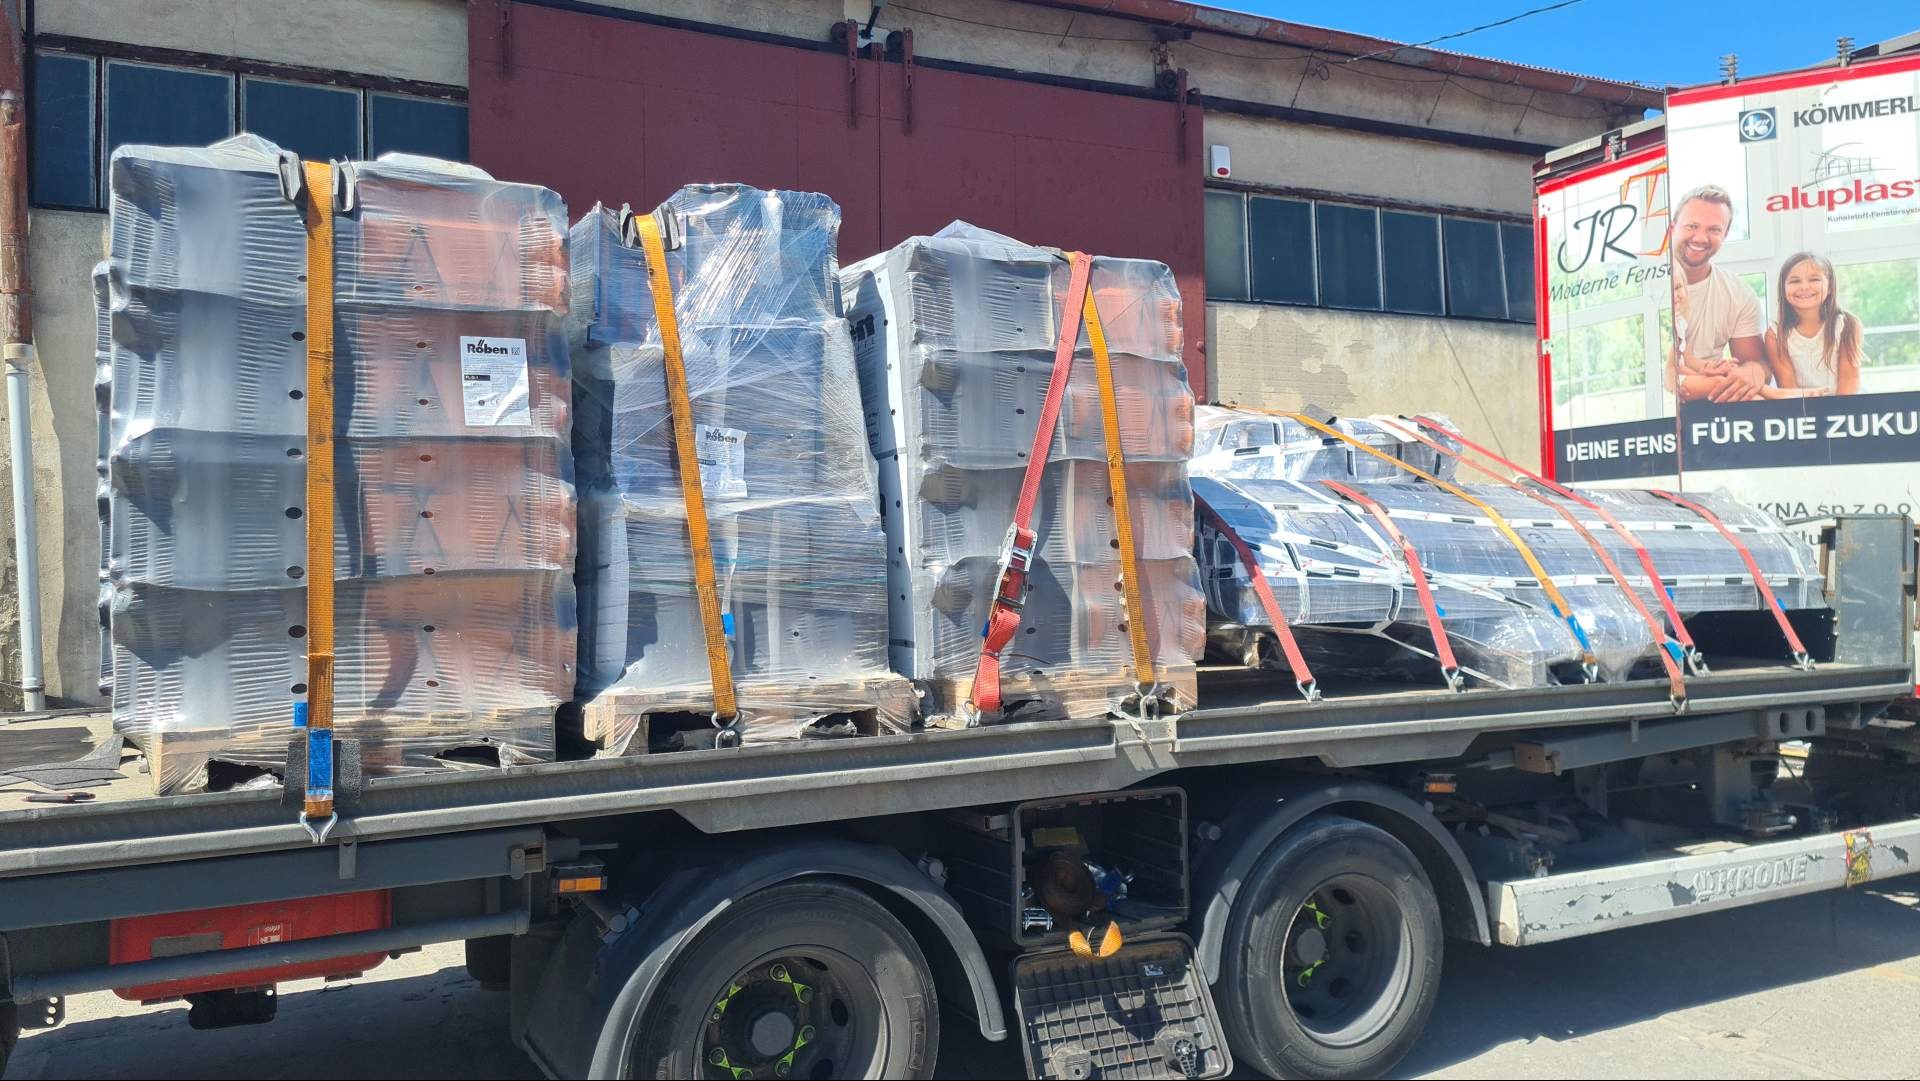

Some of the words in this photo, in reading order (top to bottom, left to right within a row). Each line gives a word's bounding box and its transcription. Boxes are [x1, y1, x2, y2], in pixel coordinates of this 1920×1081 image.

[1766, 179, 1920, 212] aluplas
[1557, 204, 1638, 274] JR
[1549, 274, 1619, 301] Moderne
[467, 339, 508, 355] Röben
[705, 428, 738, 444] Röben
[1692, 416, 1755, 446] FÜR
[1764, 416, 1817, 442] DIE
[1826, 411, 1920, 439] ZUKU
[1566, 439, 1620, 462] DEINE
[1624, 433, 1678, 456] FENS
[1757, 501, 1810, 519] KNA
[1717, 854, 1808, 896] KRONE
